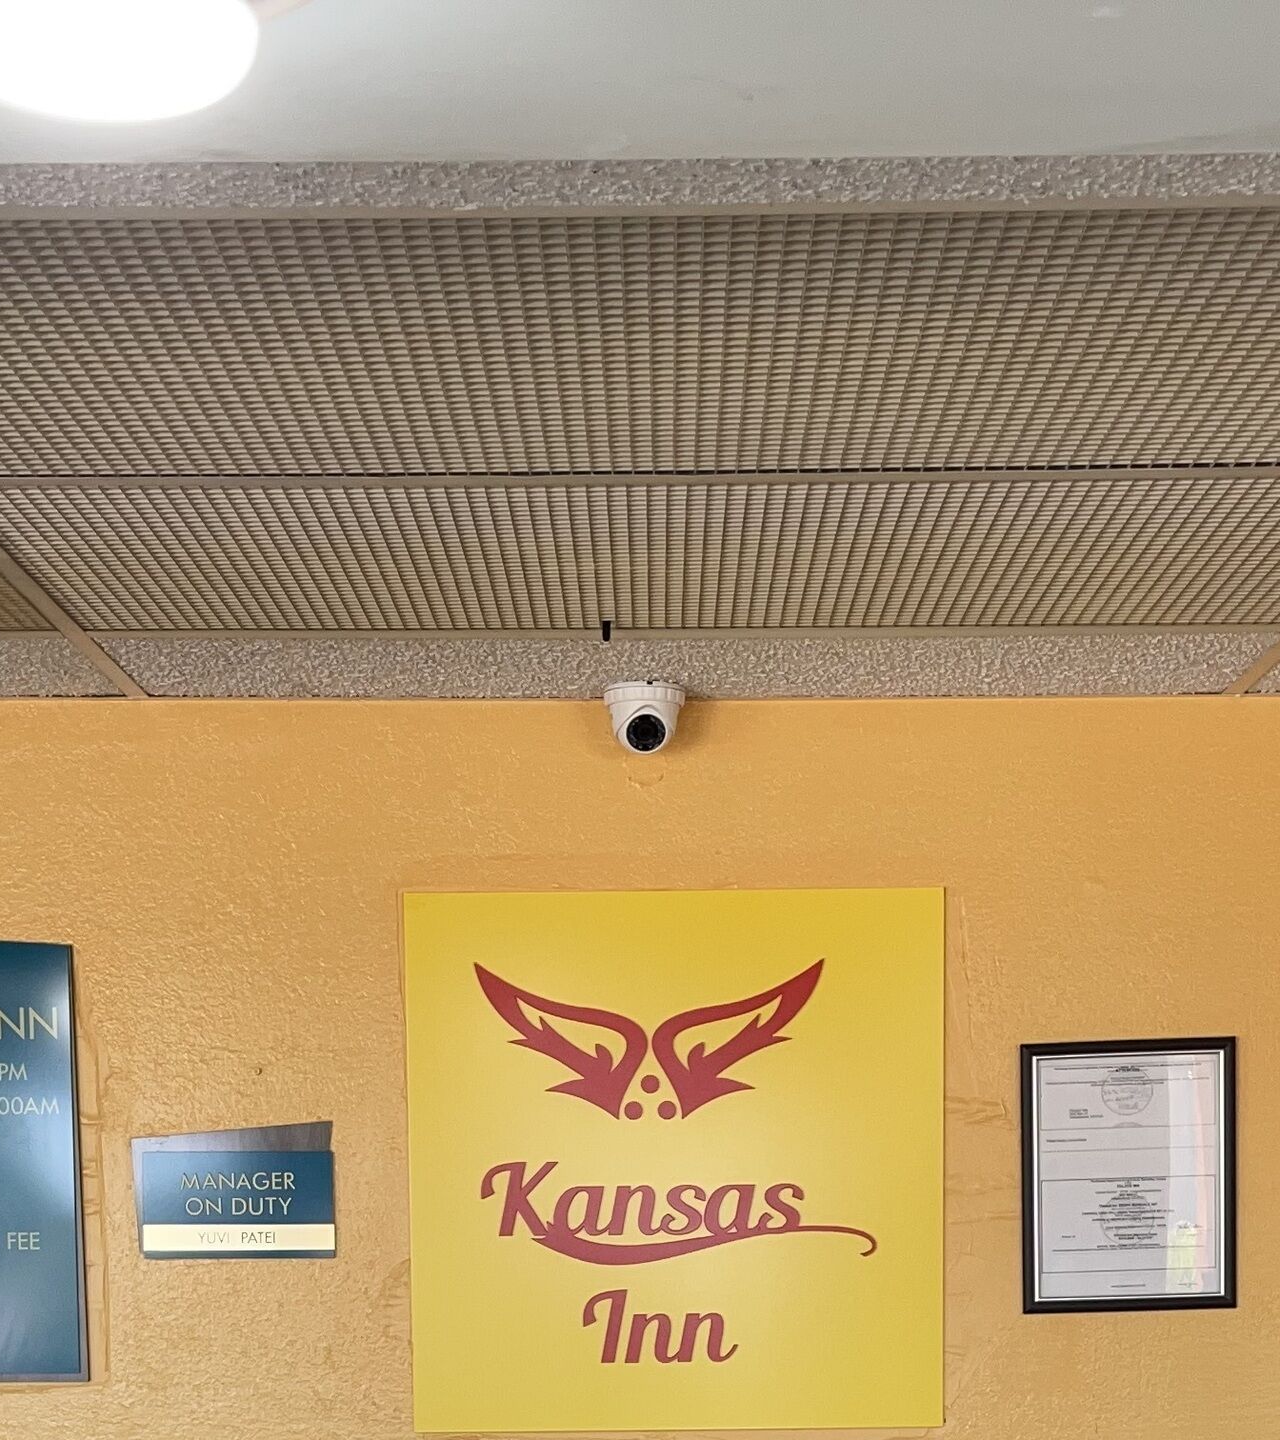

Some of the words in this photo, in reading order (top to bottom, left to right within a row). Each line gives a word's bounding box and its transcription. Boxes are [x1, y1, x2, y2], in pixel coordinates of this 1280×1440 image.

[180, 1172, 296, 1191] MANAGER
[185, 1197, 225, 1216] ON
[232, 1196, 292, 1216] DUTY
[480, 1161, 835, 1258] Kansas
[8, 1232, 41, 1251] FEE
[198, 1231, 231, 1244] YUVI
[582, 1289, 738, 1364] Inn
